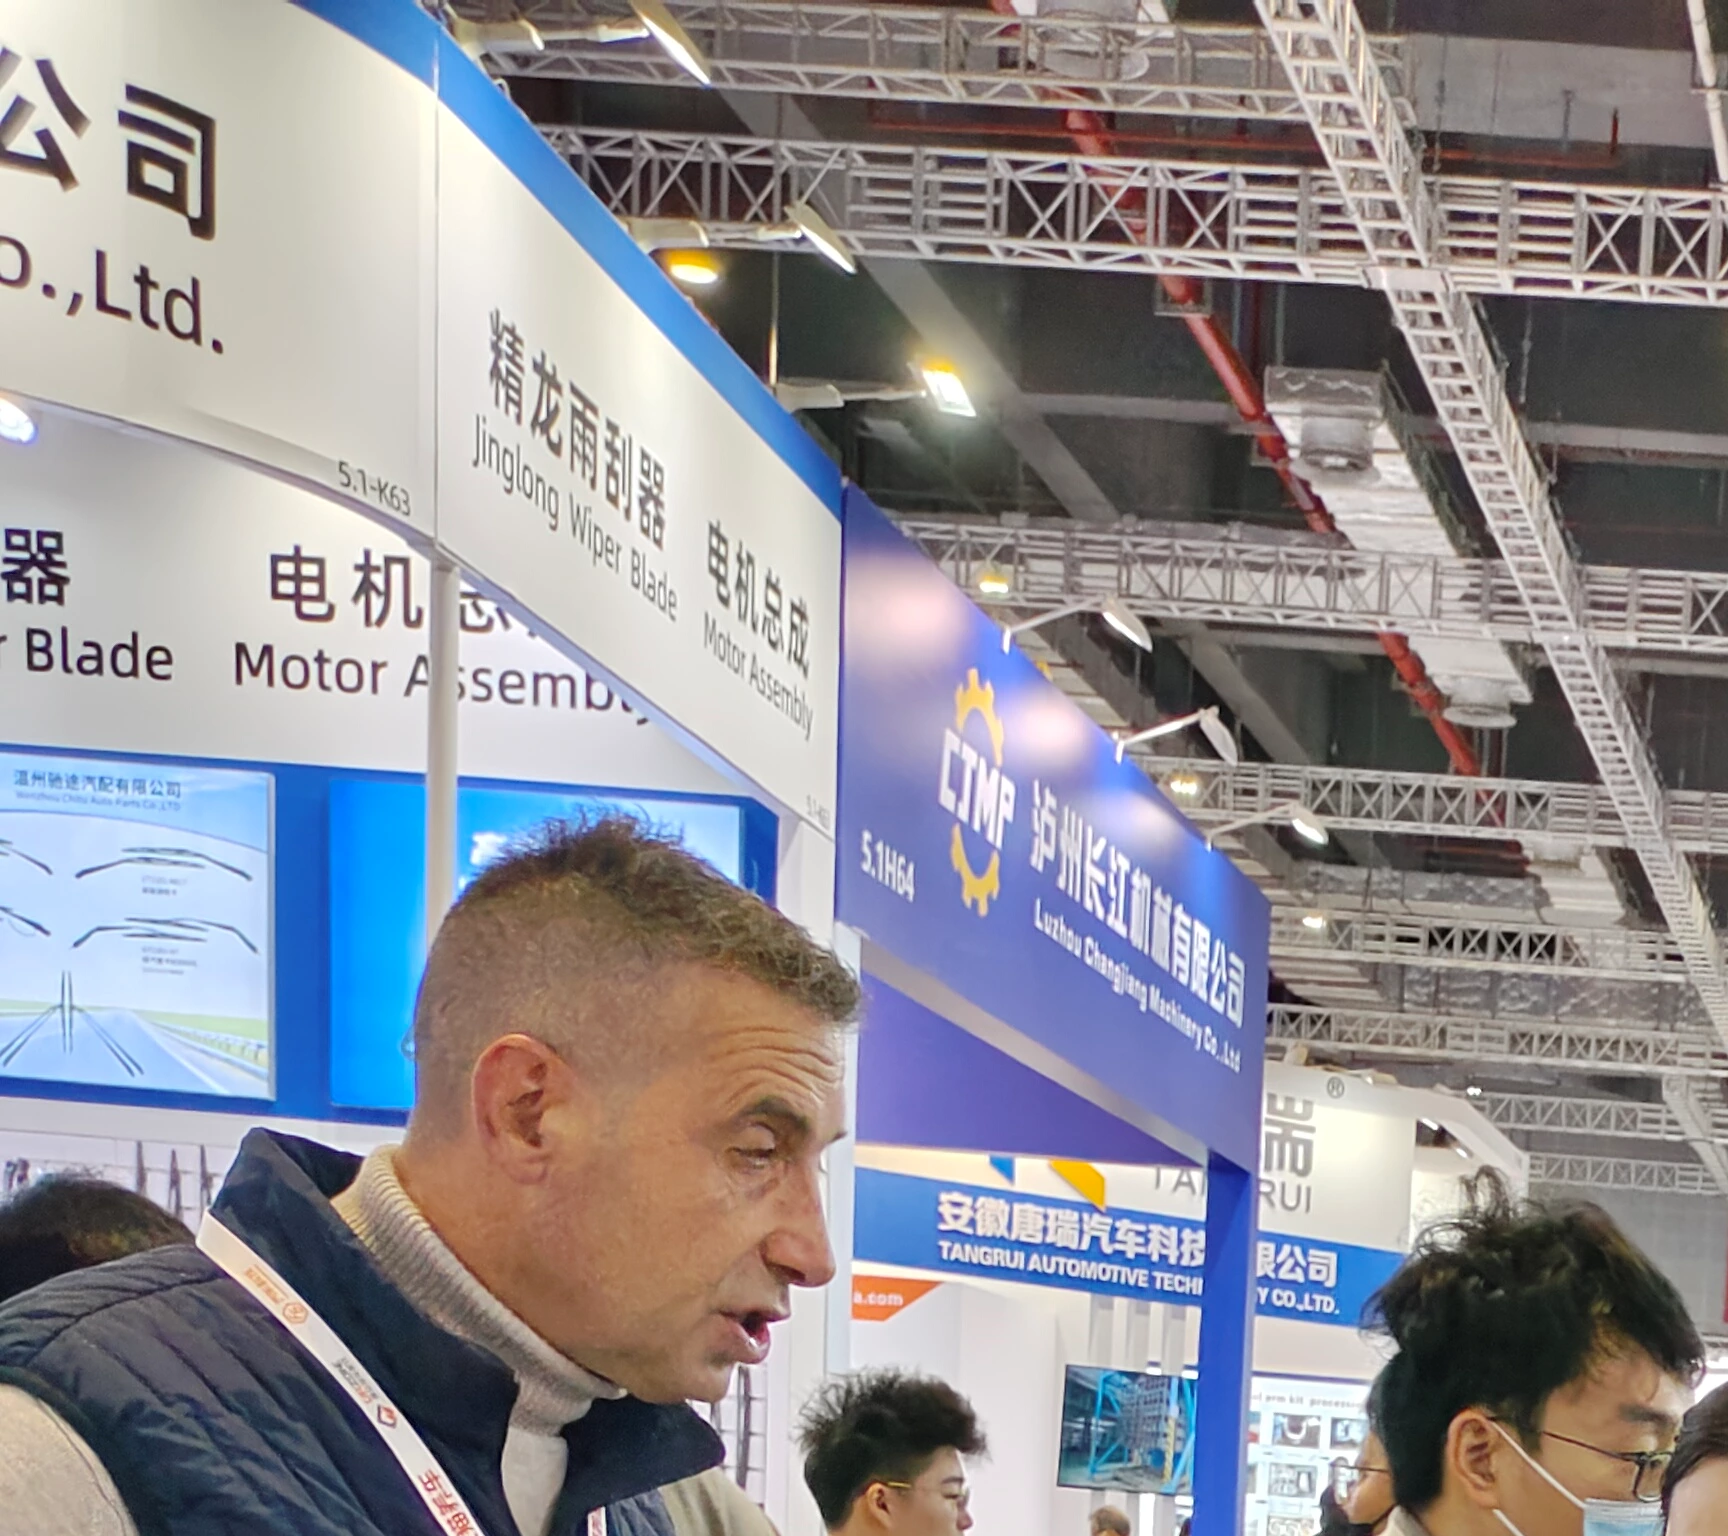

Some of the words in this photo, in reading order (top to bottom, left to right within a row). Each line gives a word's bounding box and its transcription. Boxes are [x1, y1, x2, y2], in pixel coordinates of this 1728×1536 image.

[337, 459, 412, 517] 5.1-K63
[488, 307, 665, 552] 精龙雨刮器
[708, 519, 810, 680] 电机总成
[1, 527, 70, 606] 器
[472, 413, 560, 532] Jinglong
[568, 492, 623, 574] Wiper
[631, 547, 678, 622] Blade
[704, 611, 746, 675] Motor
[749, 657, 814, 741] Assembly
[26, 625, 174, 682] Blade
[234, 641, 388, 695] Motor
[861, 829, 915, 903] 5.1H64
[1029, 779, 1246, 1028] 泸州长江机械有限公司
[1034, 897, 1082, 957] Luzhou
[1083, 936, 1148, 1013] Changjiang
[1149, 984, 1202, 1051] Machinery
[938, 1240, 1024, 1271] TANGRUI
[1027, 1252, 1149, 1288] AUTOMOTIVE
